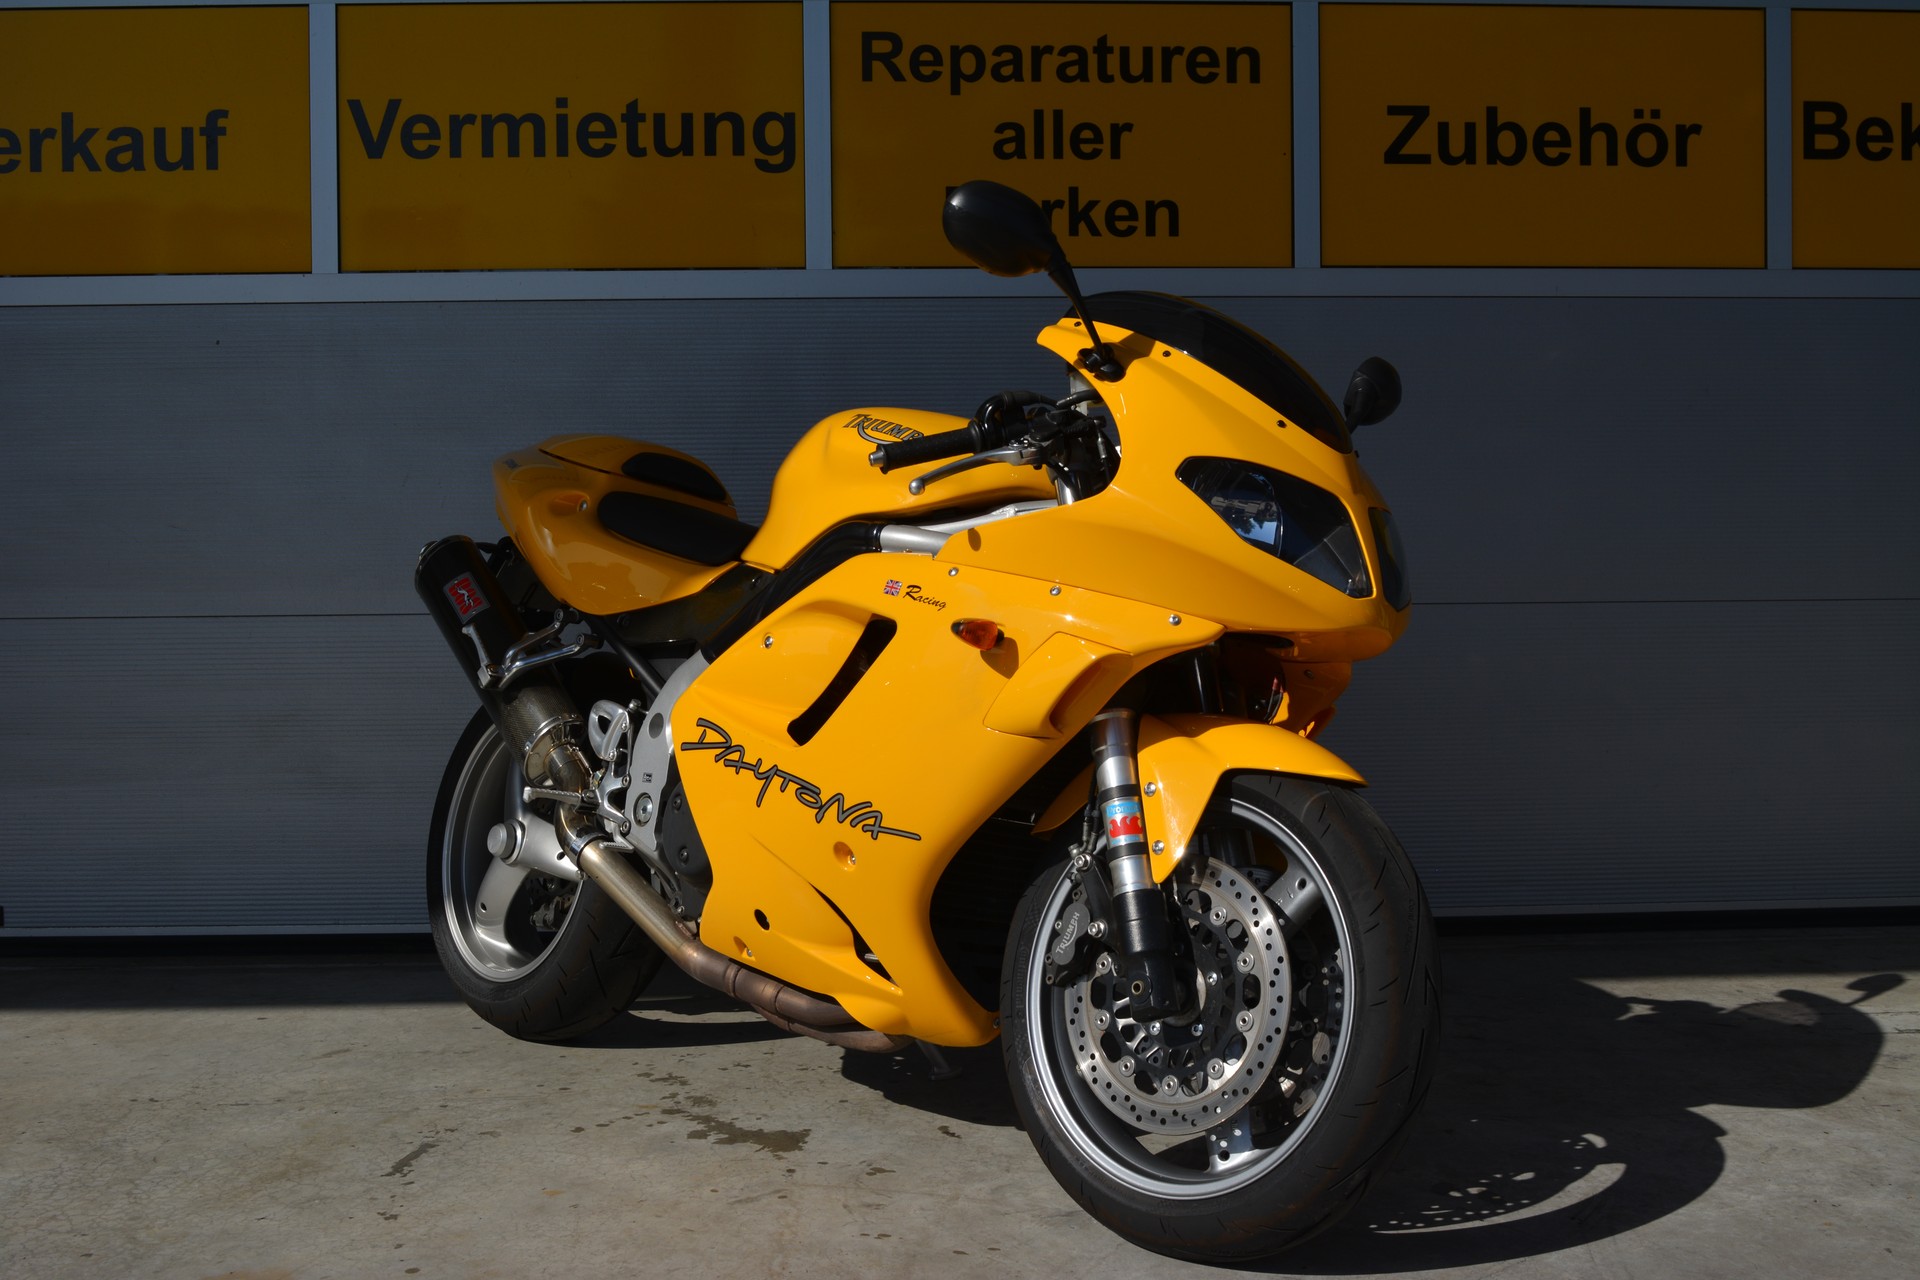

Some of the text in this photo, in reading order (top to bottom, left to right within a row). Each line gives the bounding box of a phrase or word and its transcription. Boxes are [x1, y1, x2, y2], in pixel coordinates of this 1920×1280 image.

[861, 31, 1261, 95] Reparaturen
[347, 97, 797, 174] Vermietung
[992, 109, 1134, 160] aller
[1384, 105, 1703, 167] Zubehör
[903, 584, 947, 611] Racing
[681, 717, 922, 841] DAYTONA
[1055, 911, 1080, 954] TRIUMPH
